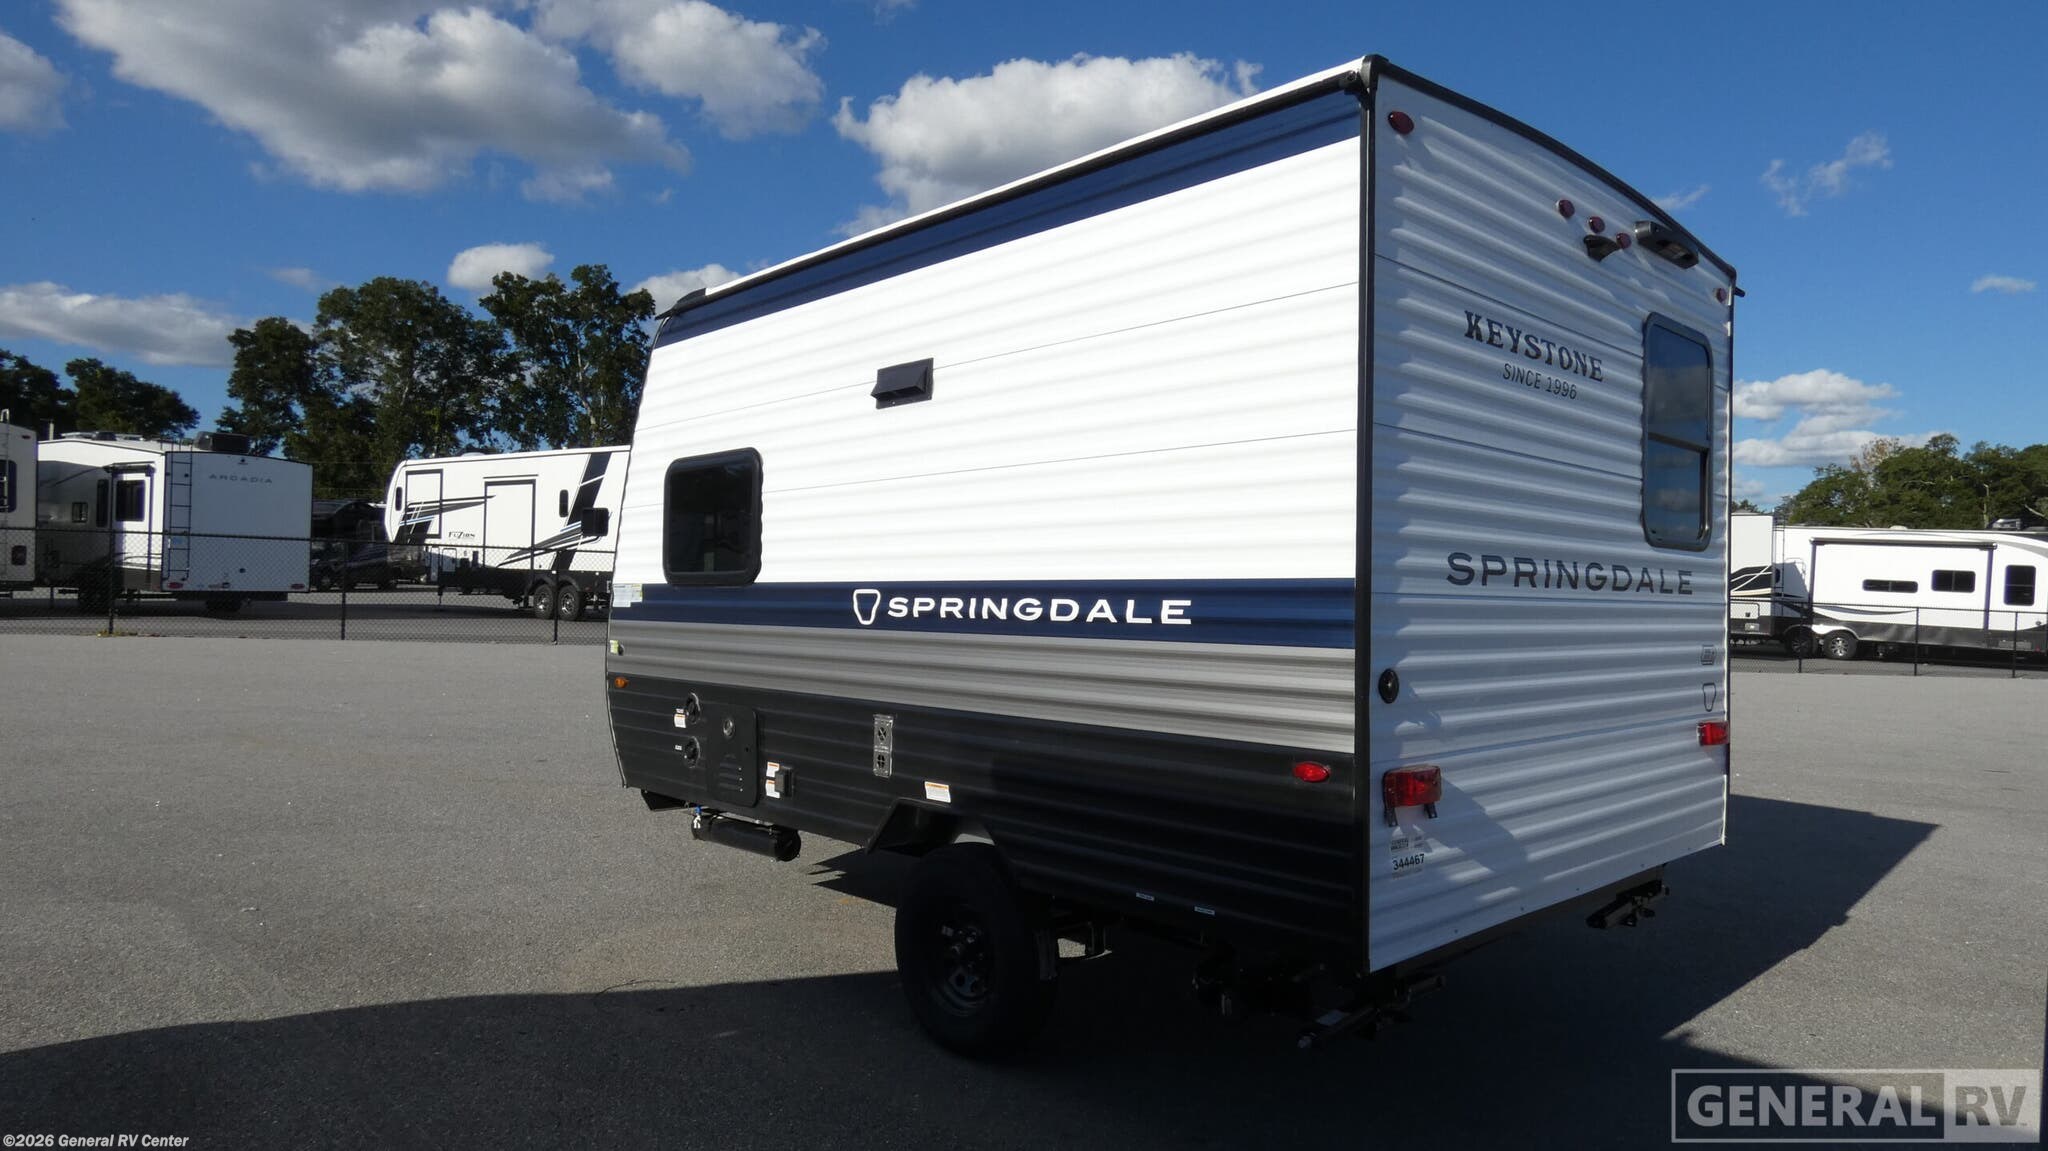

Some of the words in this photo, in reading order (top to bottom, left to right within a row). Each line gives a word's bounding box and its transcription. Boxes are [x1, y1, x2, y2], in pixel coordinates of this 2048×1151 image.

[1464, 310, 1604, 382] KEYSTONE
[1502, 363, 1542, 390] SINCE
[1547, 377, 1578, 400] 1996
[208, 473, 273, 484] ARCADIA
[1446, 552, 1693, 595] SPRINGDALE
[887, 597, 1192, 625] SPRINGDALE
[1392, 853, 1425, 871] 344467
